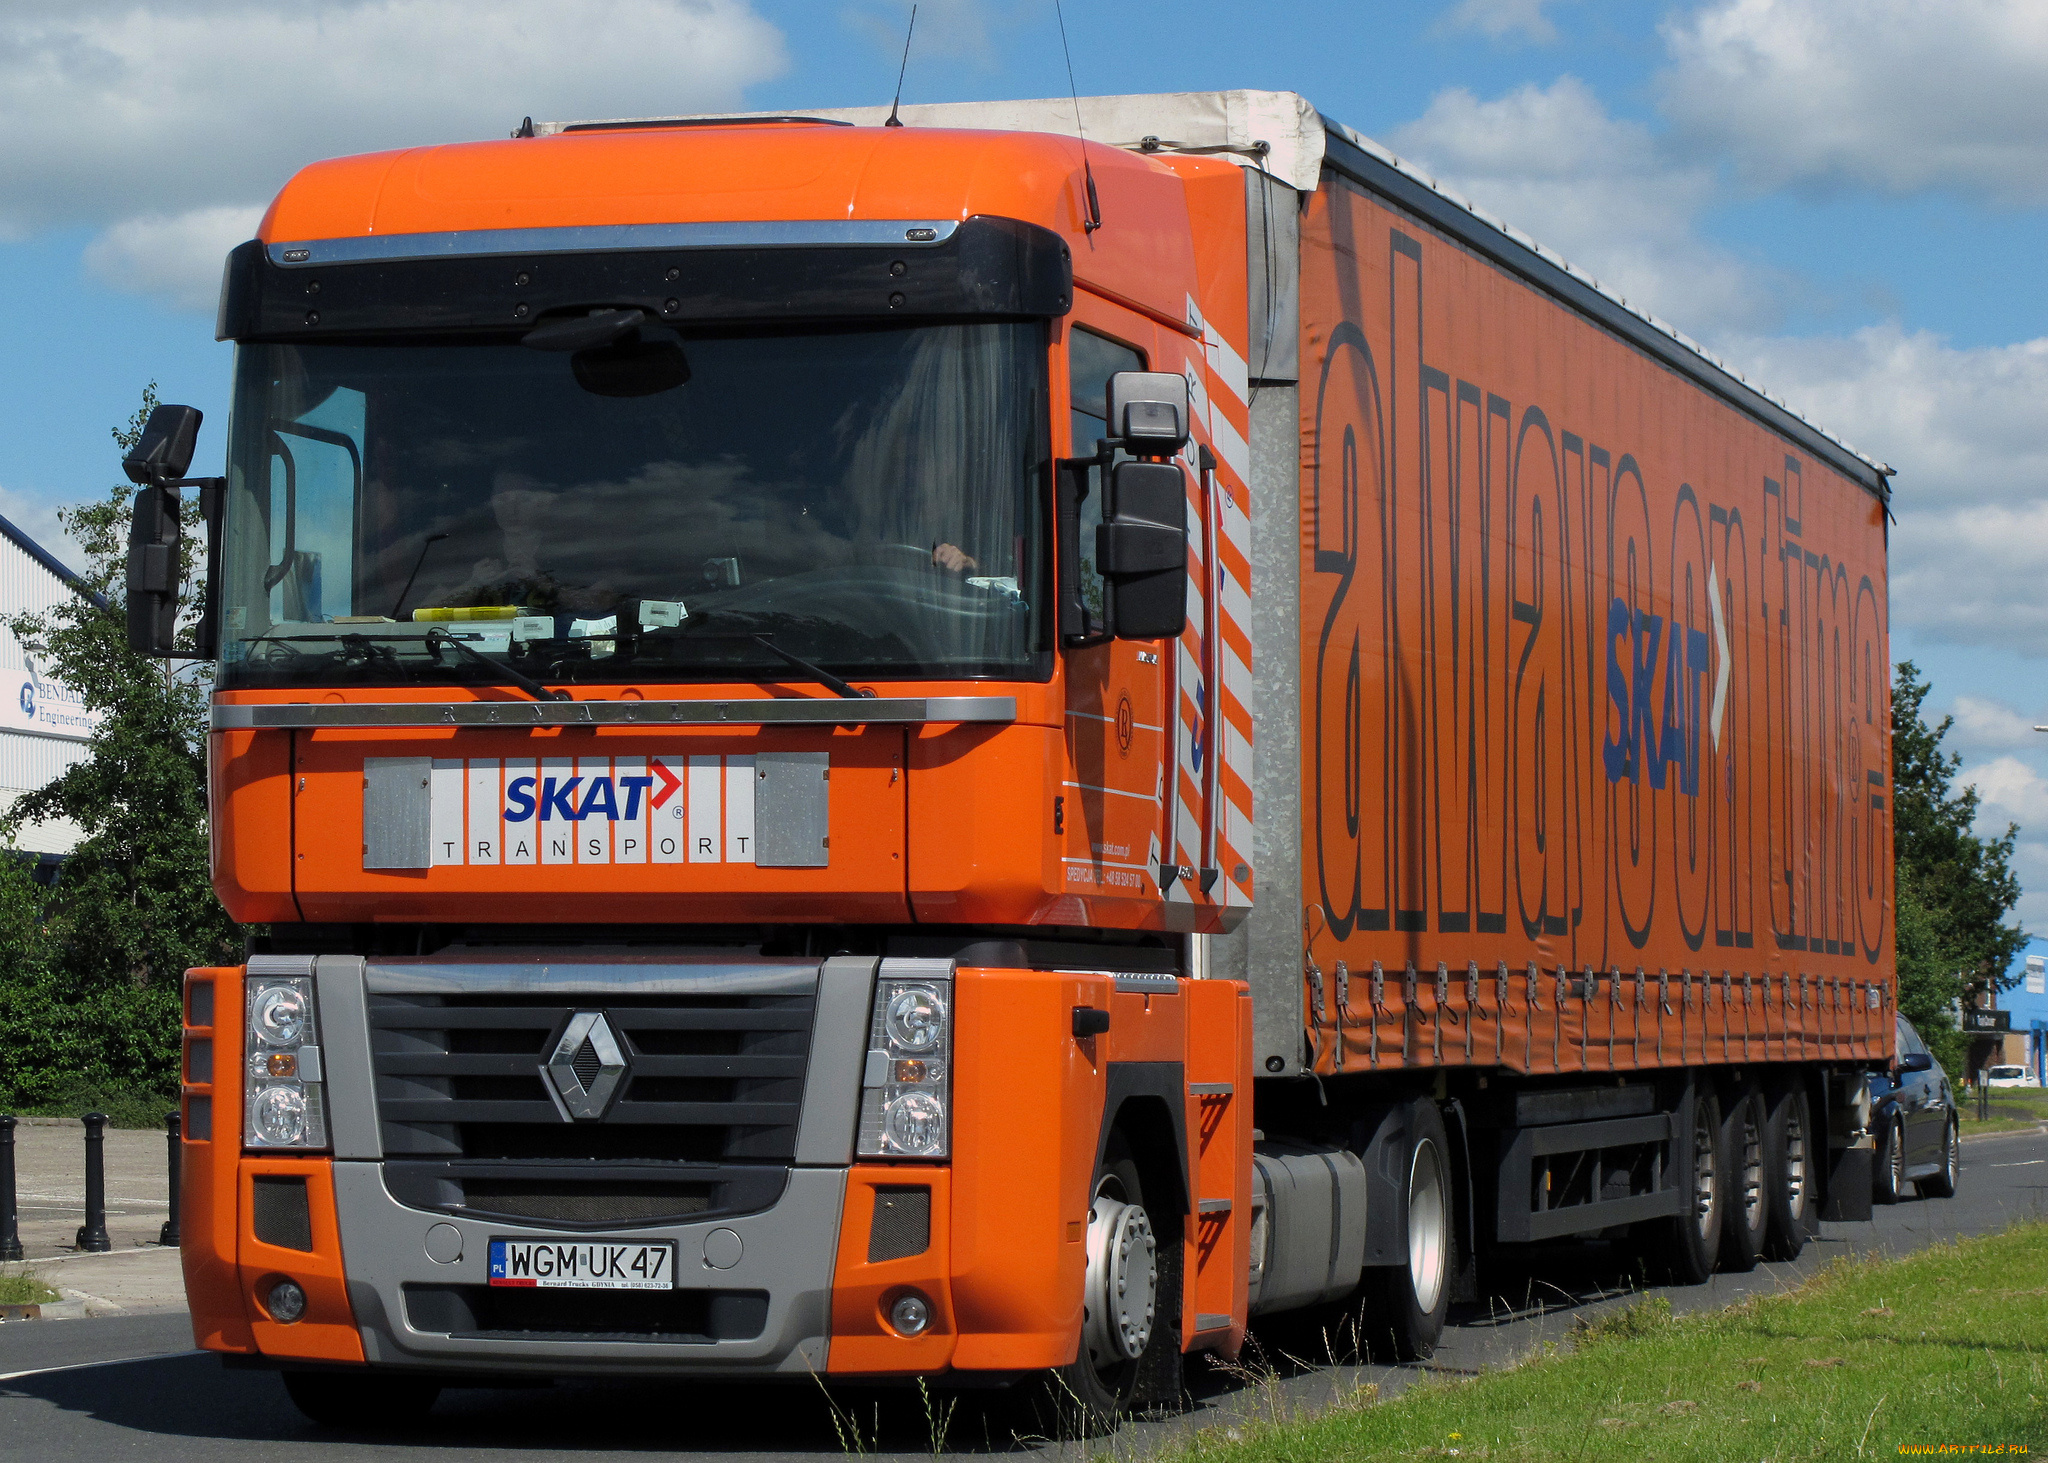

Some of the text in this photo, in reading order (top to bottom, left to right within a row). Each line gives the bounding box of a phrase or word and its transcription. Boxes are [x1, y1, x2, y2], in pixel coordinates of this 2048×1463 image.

[1603, 597, 1708, 797] SKAT
[39, 705, 94, 733] Engineering
[502, 776, 654, 823] SKAT
[443, 836, 750, 858] TRANSPORT
[493, 1245, 667, 1279] PL WGM UK47
